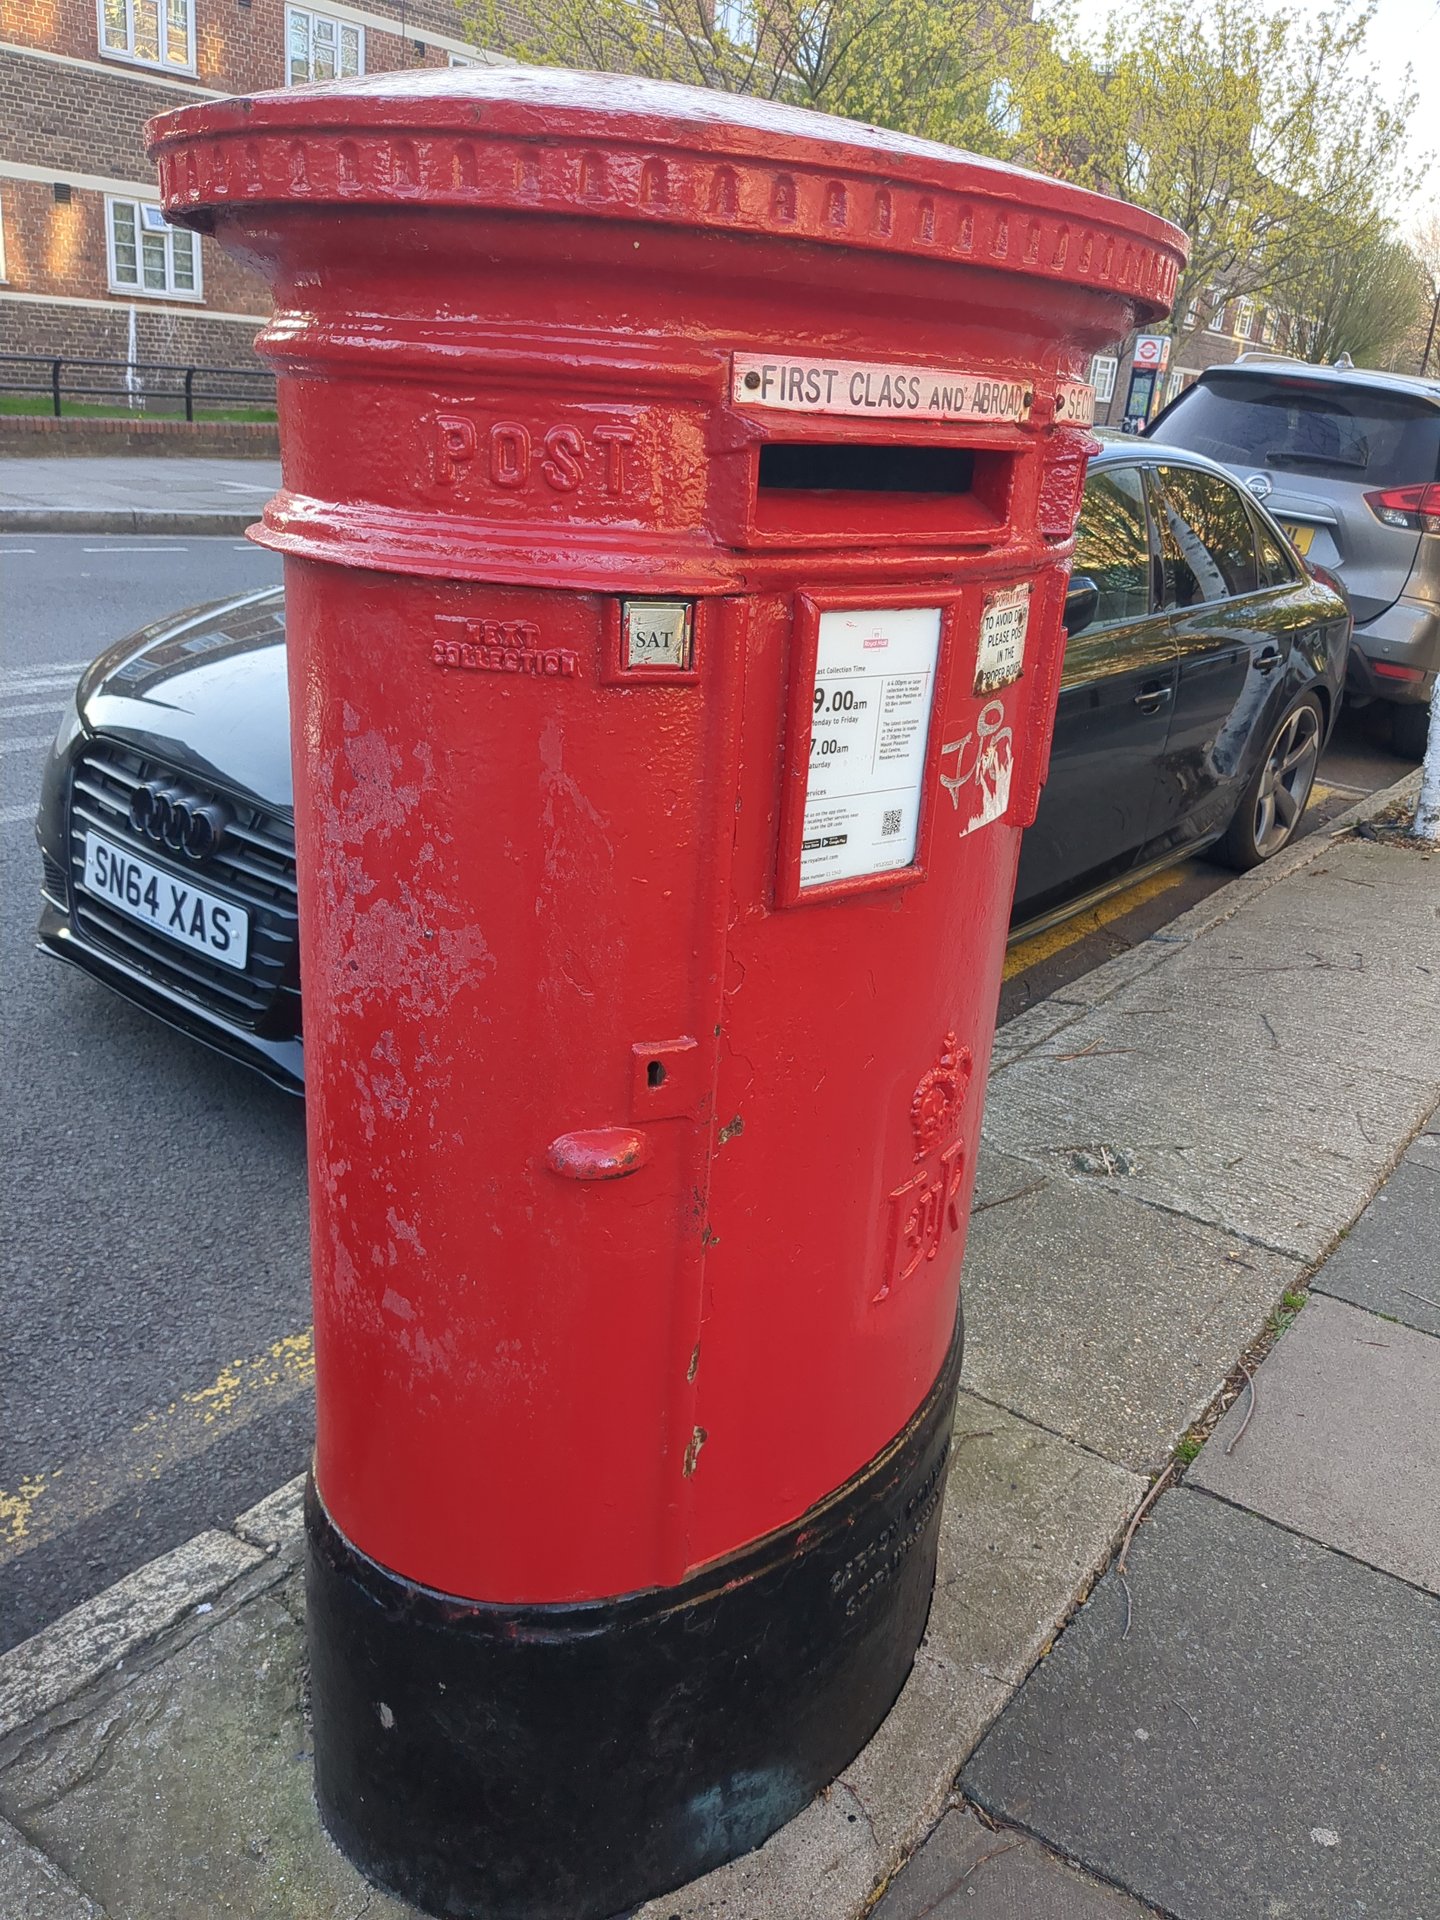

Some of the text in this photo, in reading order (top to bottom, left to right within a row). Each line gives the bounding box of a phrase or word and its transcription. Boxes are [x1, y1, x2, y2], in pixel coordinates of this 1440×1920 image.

[761, 364, 1022, 415] FIRST CLASS AND ABROAD
[436, 415, 637, 494] POST
[986, 616, 994, 630] TO
[996, 611, 1013, 628] AVOID
[465, 618, 541, 646] NEXT
[636, 631, 673, 648] SAT
[987, 625, 1024, 648] PLEASE POST
[433, 640, 579, 676] COLLECTION
[997, 646, 1015, 663] IN THE
[826, 666, 852, 674] Collection
[813, 688, 867, 713] 9.00am
[841, 716, 859, 724] Friday
[808, 761, 831, 770] aturday
[806, 788, 827, 797] ervices
[95, 845, 231, 951] SN64 XAS
